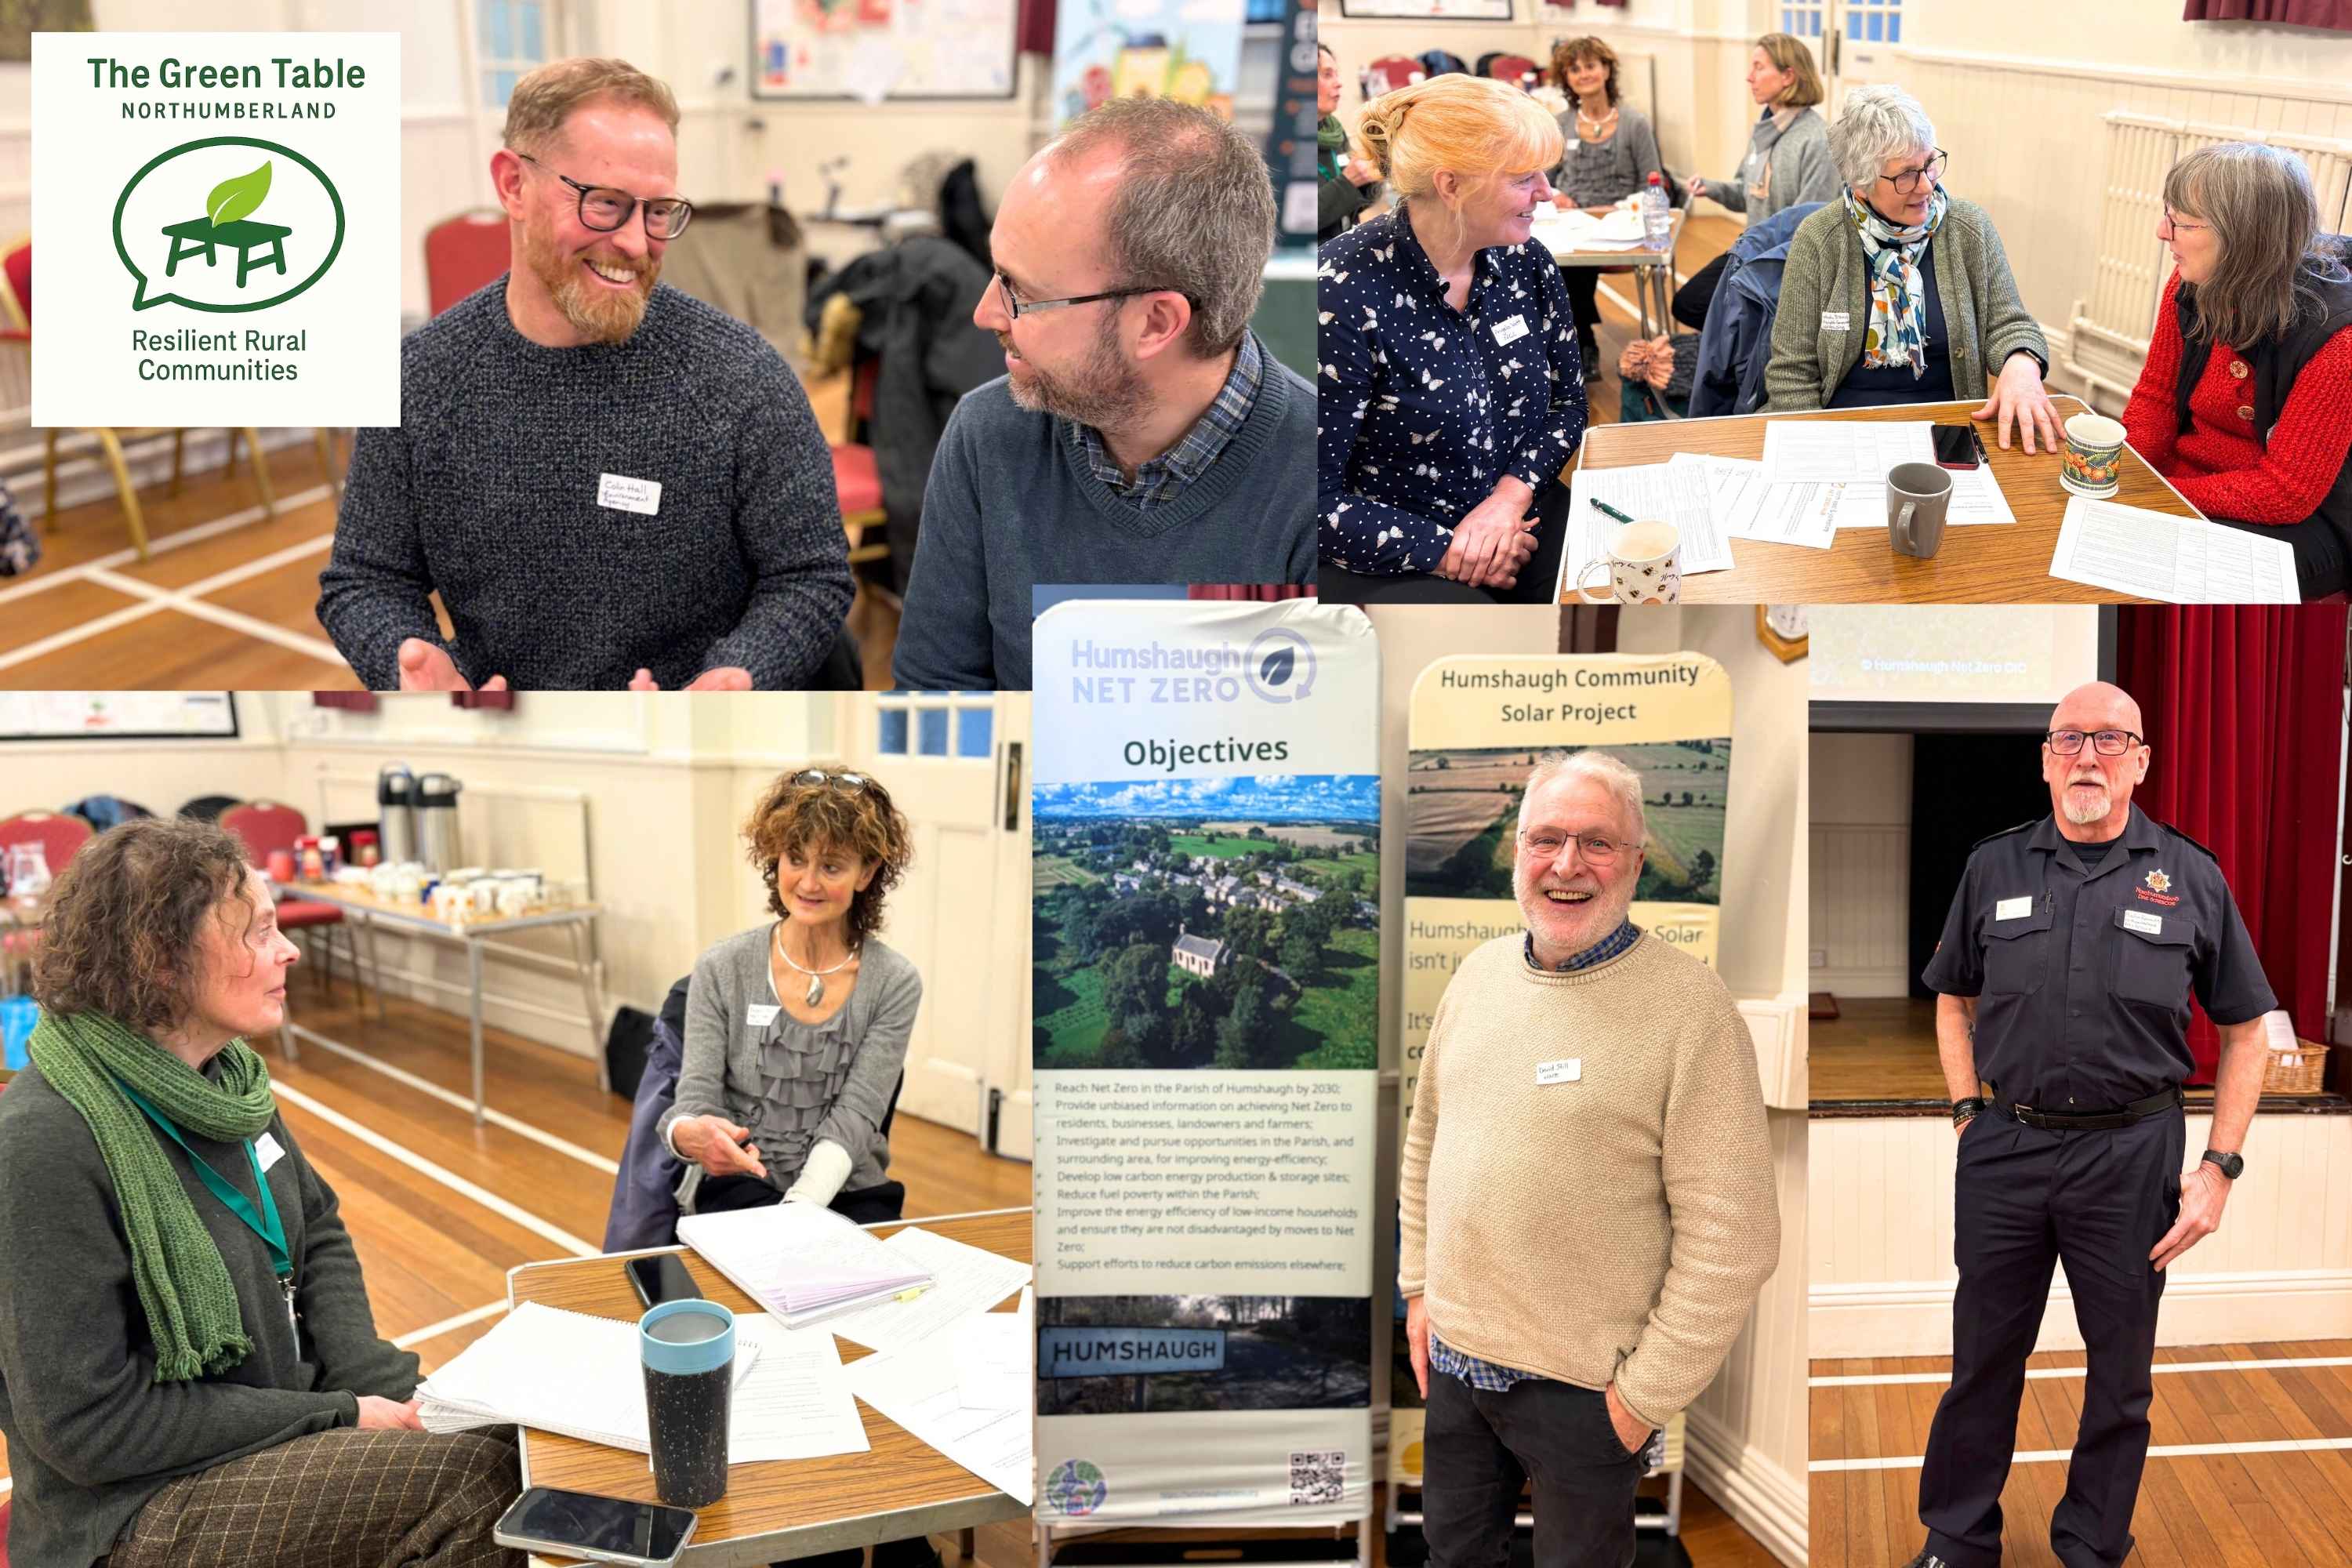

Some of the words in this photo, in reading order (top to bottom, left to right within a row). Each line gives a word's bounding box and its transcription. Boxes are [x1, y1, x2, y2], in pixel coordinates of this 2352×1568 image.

[627, 484, 647, 495] Hall
[1073, 640, 1241, 677] Humshaugh
[1441, 669, 1568, 693] Humshaugh
[1575, 664, 1700, 688] Community
[1073, 677, 1136, 703] NET
[1151, 677, 1240, 703] ZERO
[1501, 705, 1555, 723] Solar
[1562, 703, 1637, 725] Project
[1123, 737, 1289, 772] Objectives
[1655, 925, 1704, 942] Solar
[1055, 1083, 1088, 1093] Reach
[1091, 1083, 1110, 1093] Net
[1113, 1083, 1138, 1093] Zero
[1154, 1083, 1172, 1093] the
[1175, 1083, 1209, 1093] Parish
[1212, 1083, 1224, 1093] of
[1227, 1083, 1294, 1096] Humshaugh
[1296, 1084, 1309, 1096] by
[1056, 1100, 1096, 1110] Provide
[1100, 1102, 1149, 1110] unbiased
[1152, 1101, 1217, 1111] information
[1237, 1102, 1288, 1113] achieving
[1291, 1102, 1310, 1111] Net
[1314, 1102, 1338, 1112] Zero
[1341, 1102, 1352, 1112] to
[1178, 1120, 1240, 1129] landowners
[1243, 1120, 1265, 1129] and
[1057, 1135, 1116, 1148] Investigate
[1120, 1137, 1140, 1146] and
[1143, 1138, 1181, 1148] pursue
[1184, 1138, 1258, 1148] opportunities
[1273, 1138, 1290, 1146] the
[1333, 1137, 1354, 1147] and
[1057, 1155, 1123, 1167] surrounding
[1156, 1154, 1171, 1163] for
[1175, 1156, 1230, 1166] improving
[1058, 1171, 1101, 1183] Develop
[1125, 1172, 1163, 1181] carbon
[1165, 1174, 1203, 1184] energy
[1207, 1172, 1265, 1183] production
[1268, 1172, 1277, 1181] &
[1279, 1173, 1320, 1185] storage
[1058, 1189, 1097, 1200] Reduce
[1100, 1189, 1120, 1199] fuel
[1123, 1190, 1163, 1201] poverty
[1203, 1190, 1220, 1199] the
[1058, 1207, 1102, 1218] Improve
[1105, 1207, 1123, 1216] the
[1126, 1209, 1163, 1218] energy
[1166, 1207, 1216, 1218] efficiency
[1218, 1207, 1230, 1216] of
[1232, 1207, 1294, 1217] low-income
[1297, 1207, 1358, 1218] households
[1057, 1225, 1078, 1235] and
[1120, 1225, 1144, 1236] they
[1167, 1225, 1184, 1234] not
[1187, 1225, 1266, 1237] disadvantaged
[1269, 1225, 1282, 1237] by
[1322, 1227, 1333, 1236] to
[1335, 1226, 1354, 1236] Net
[1058, 1260, 1101, 1272] Support
[1103, 1258, 1139, 1269] efforts
[1142, 1260, 1152, 1269] to
[1156, 1259, 1192, 1269] reduce
[1194, 1259, 1232, 1269] carbon
[1234, 1261, 1287, 1269] emissions
[1054, 1341, 1217, 1363] HUMSHAUGH
